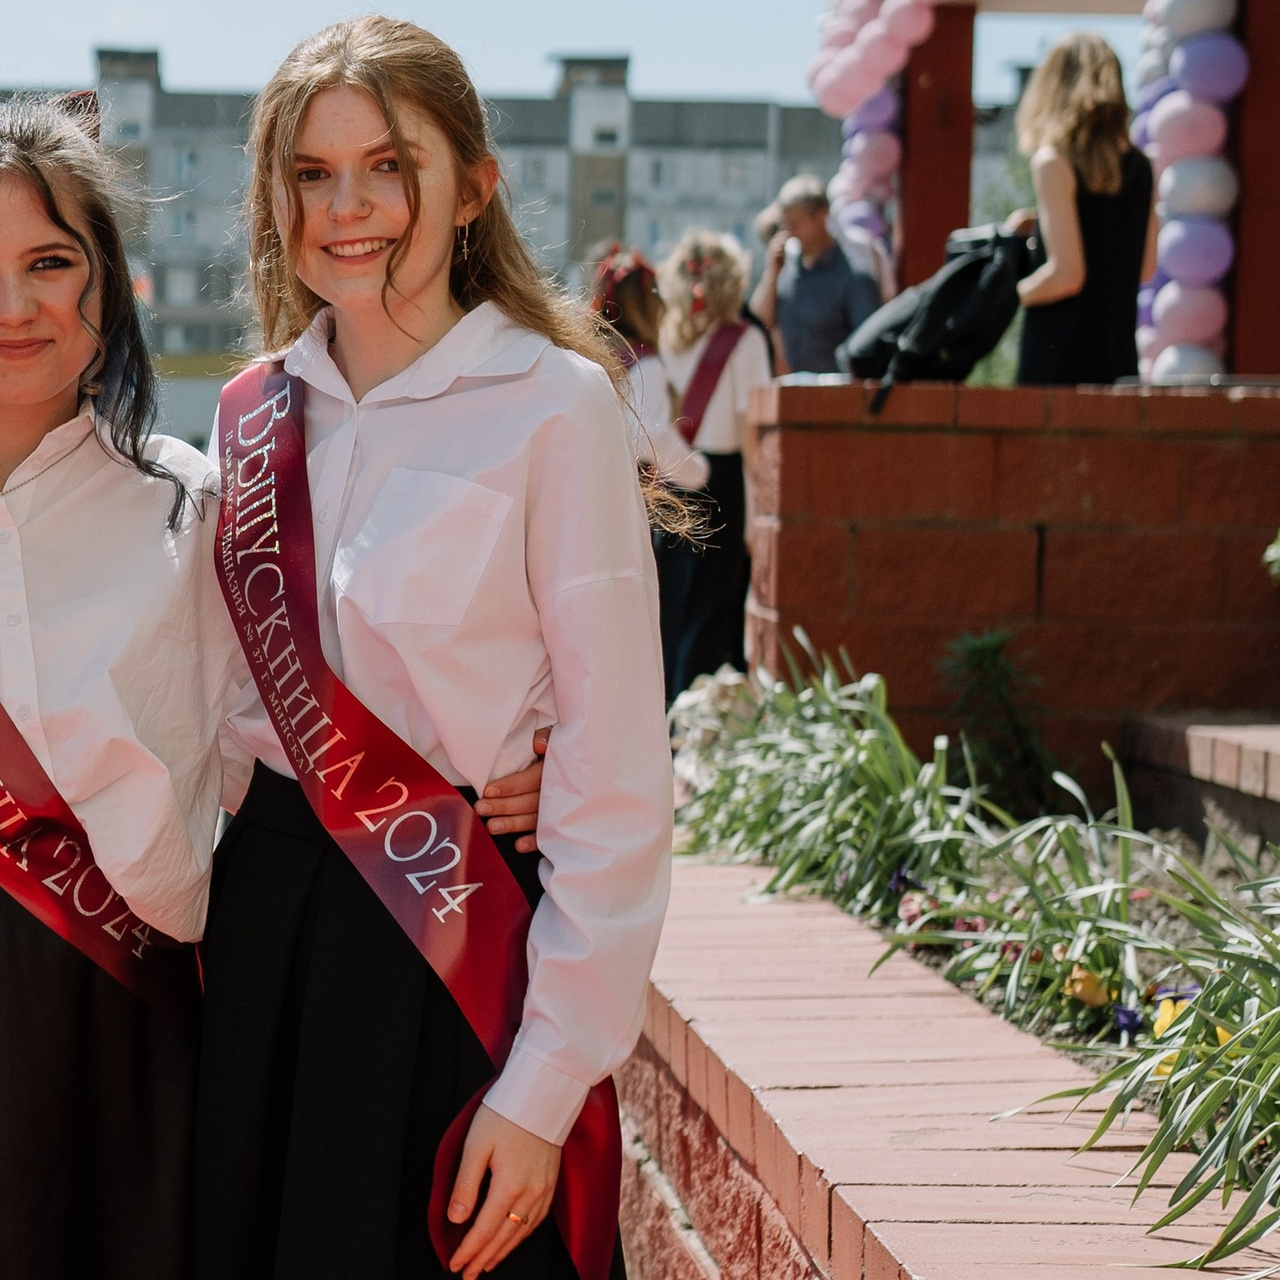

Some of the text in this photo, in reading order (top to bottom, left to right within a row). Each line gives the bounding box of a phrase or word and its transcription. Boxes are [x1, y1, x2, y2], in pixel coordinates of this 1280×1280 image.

[221, 520, 247, 618] ГИМНАЗИЯ
[242, 622, 255, 644] №
[251, 648, 264, 666] 37
[268, 693, 305, 771] МИНСКА
[353, 775, 484, 924] 2024
